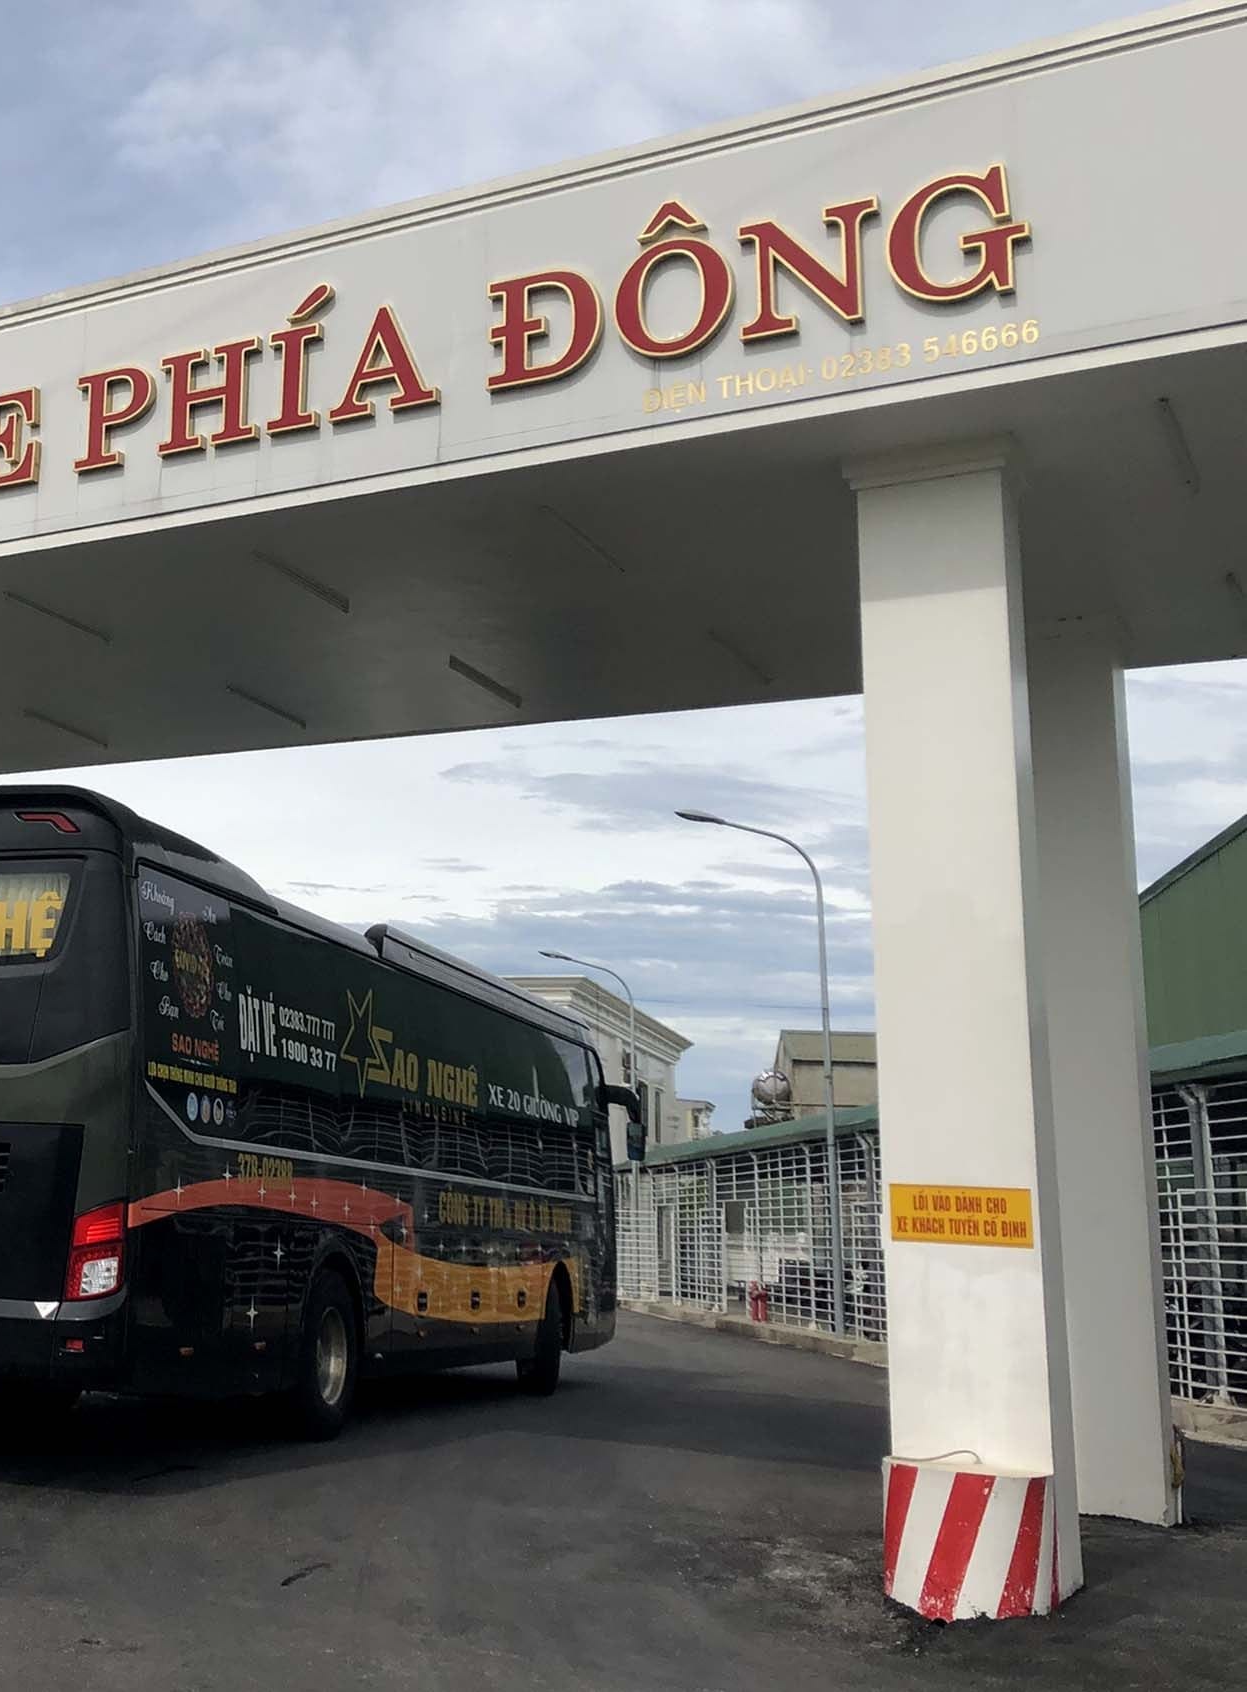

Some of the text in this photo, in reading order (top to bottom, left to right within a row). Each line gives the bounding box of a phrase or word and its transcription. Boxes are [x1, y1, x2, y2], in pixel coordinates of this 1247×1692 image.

[73, 283, 442, 475] PHÍA
[487, 163, 1032, 393] ĐÔNG
[820, 343, 912, 381] 02383
[922, 319, 1040, 363] 546666
[261, 991, 278, 1057] VÉ
[171, 1032, 193, 1056] SAO
[281, 1038, 337, 1072] 1900 33 77
[487, 1083, 504, 1108] XE
[506, 1088, 521, 1113] 20
[986, 1197, 1007, 1214] CHO
[896, 1216, 908, 1233] XE
